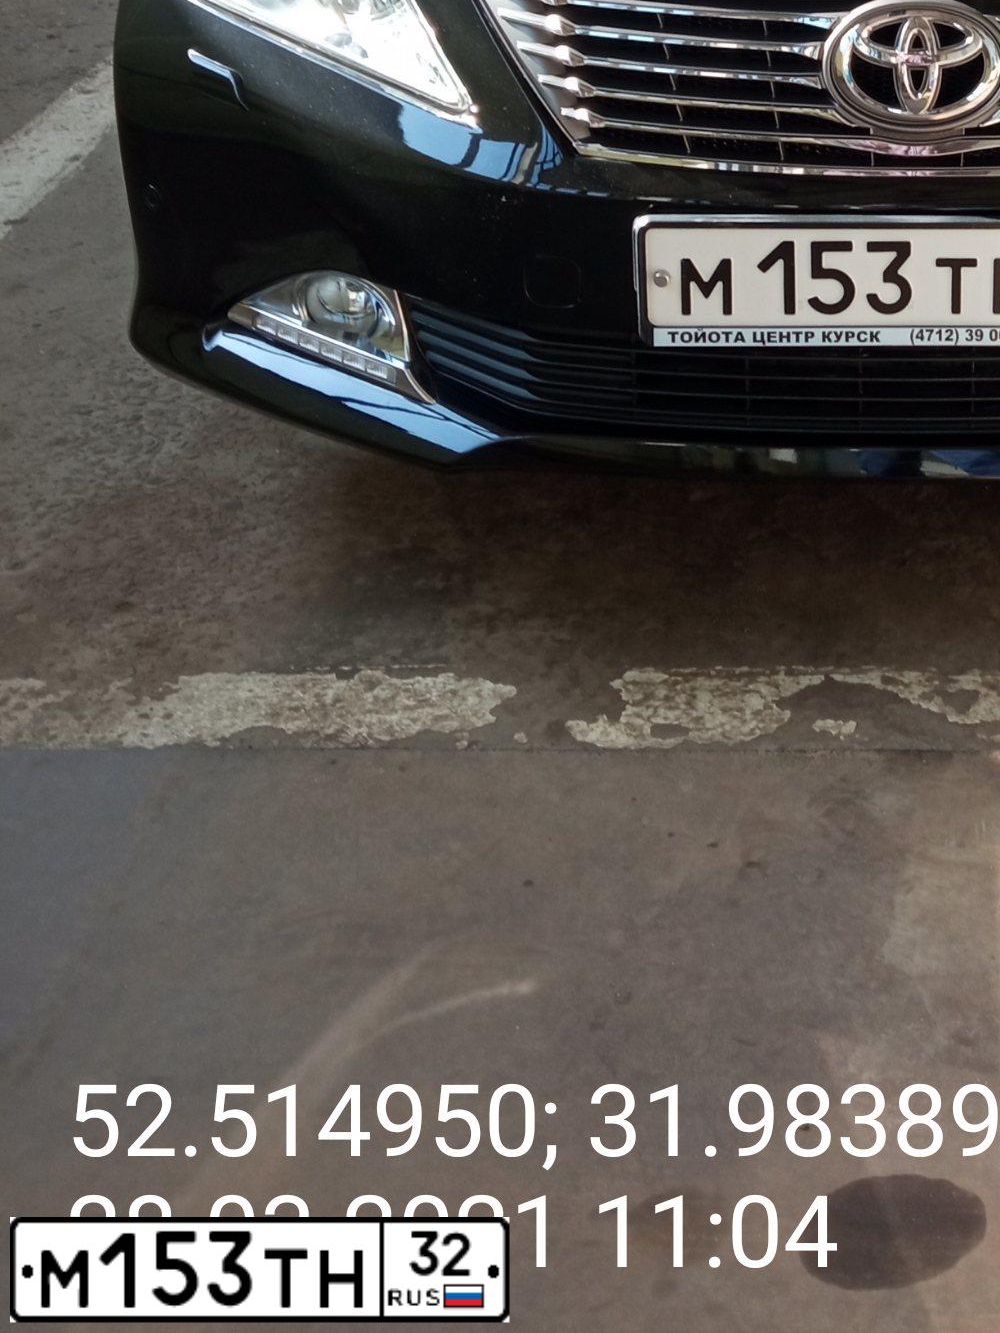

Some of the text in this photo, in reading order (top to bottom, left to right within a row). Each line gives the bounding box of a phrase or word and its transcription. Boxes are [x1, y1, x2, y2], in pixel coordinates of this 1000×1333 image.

[757, 241, 912, 315] 153
[668, 327, 881, 346] ТОЙОТА ЦЕНТР КУРСК
[909, 328, 959, 346] (4712)
[965, 329, 984, 342] 39
